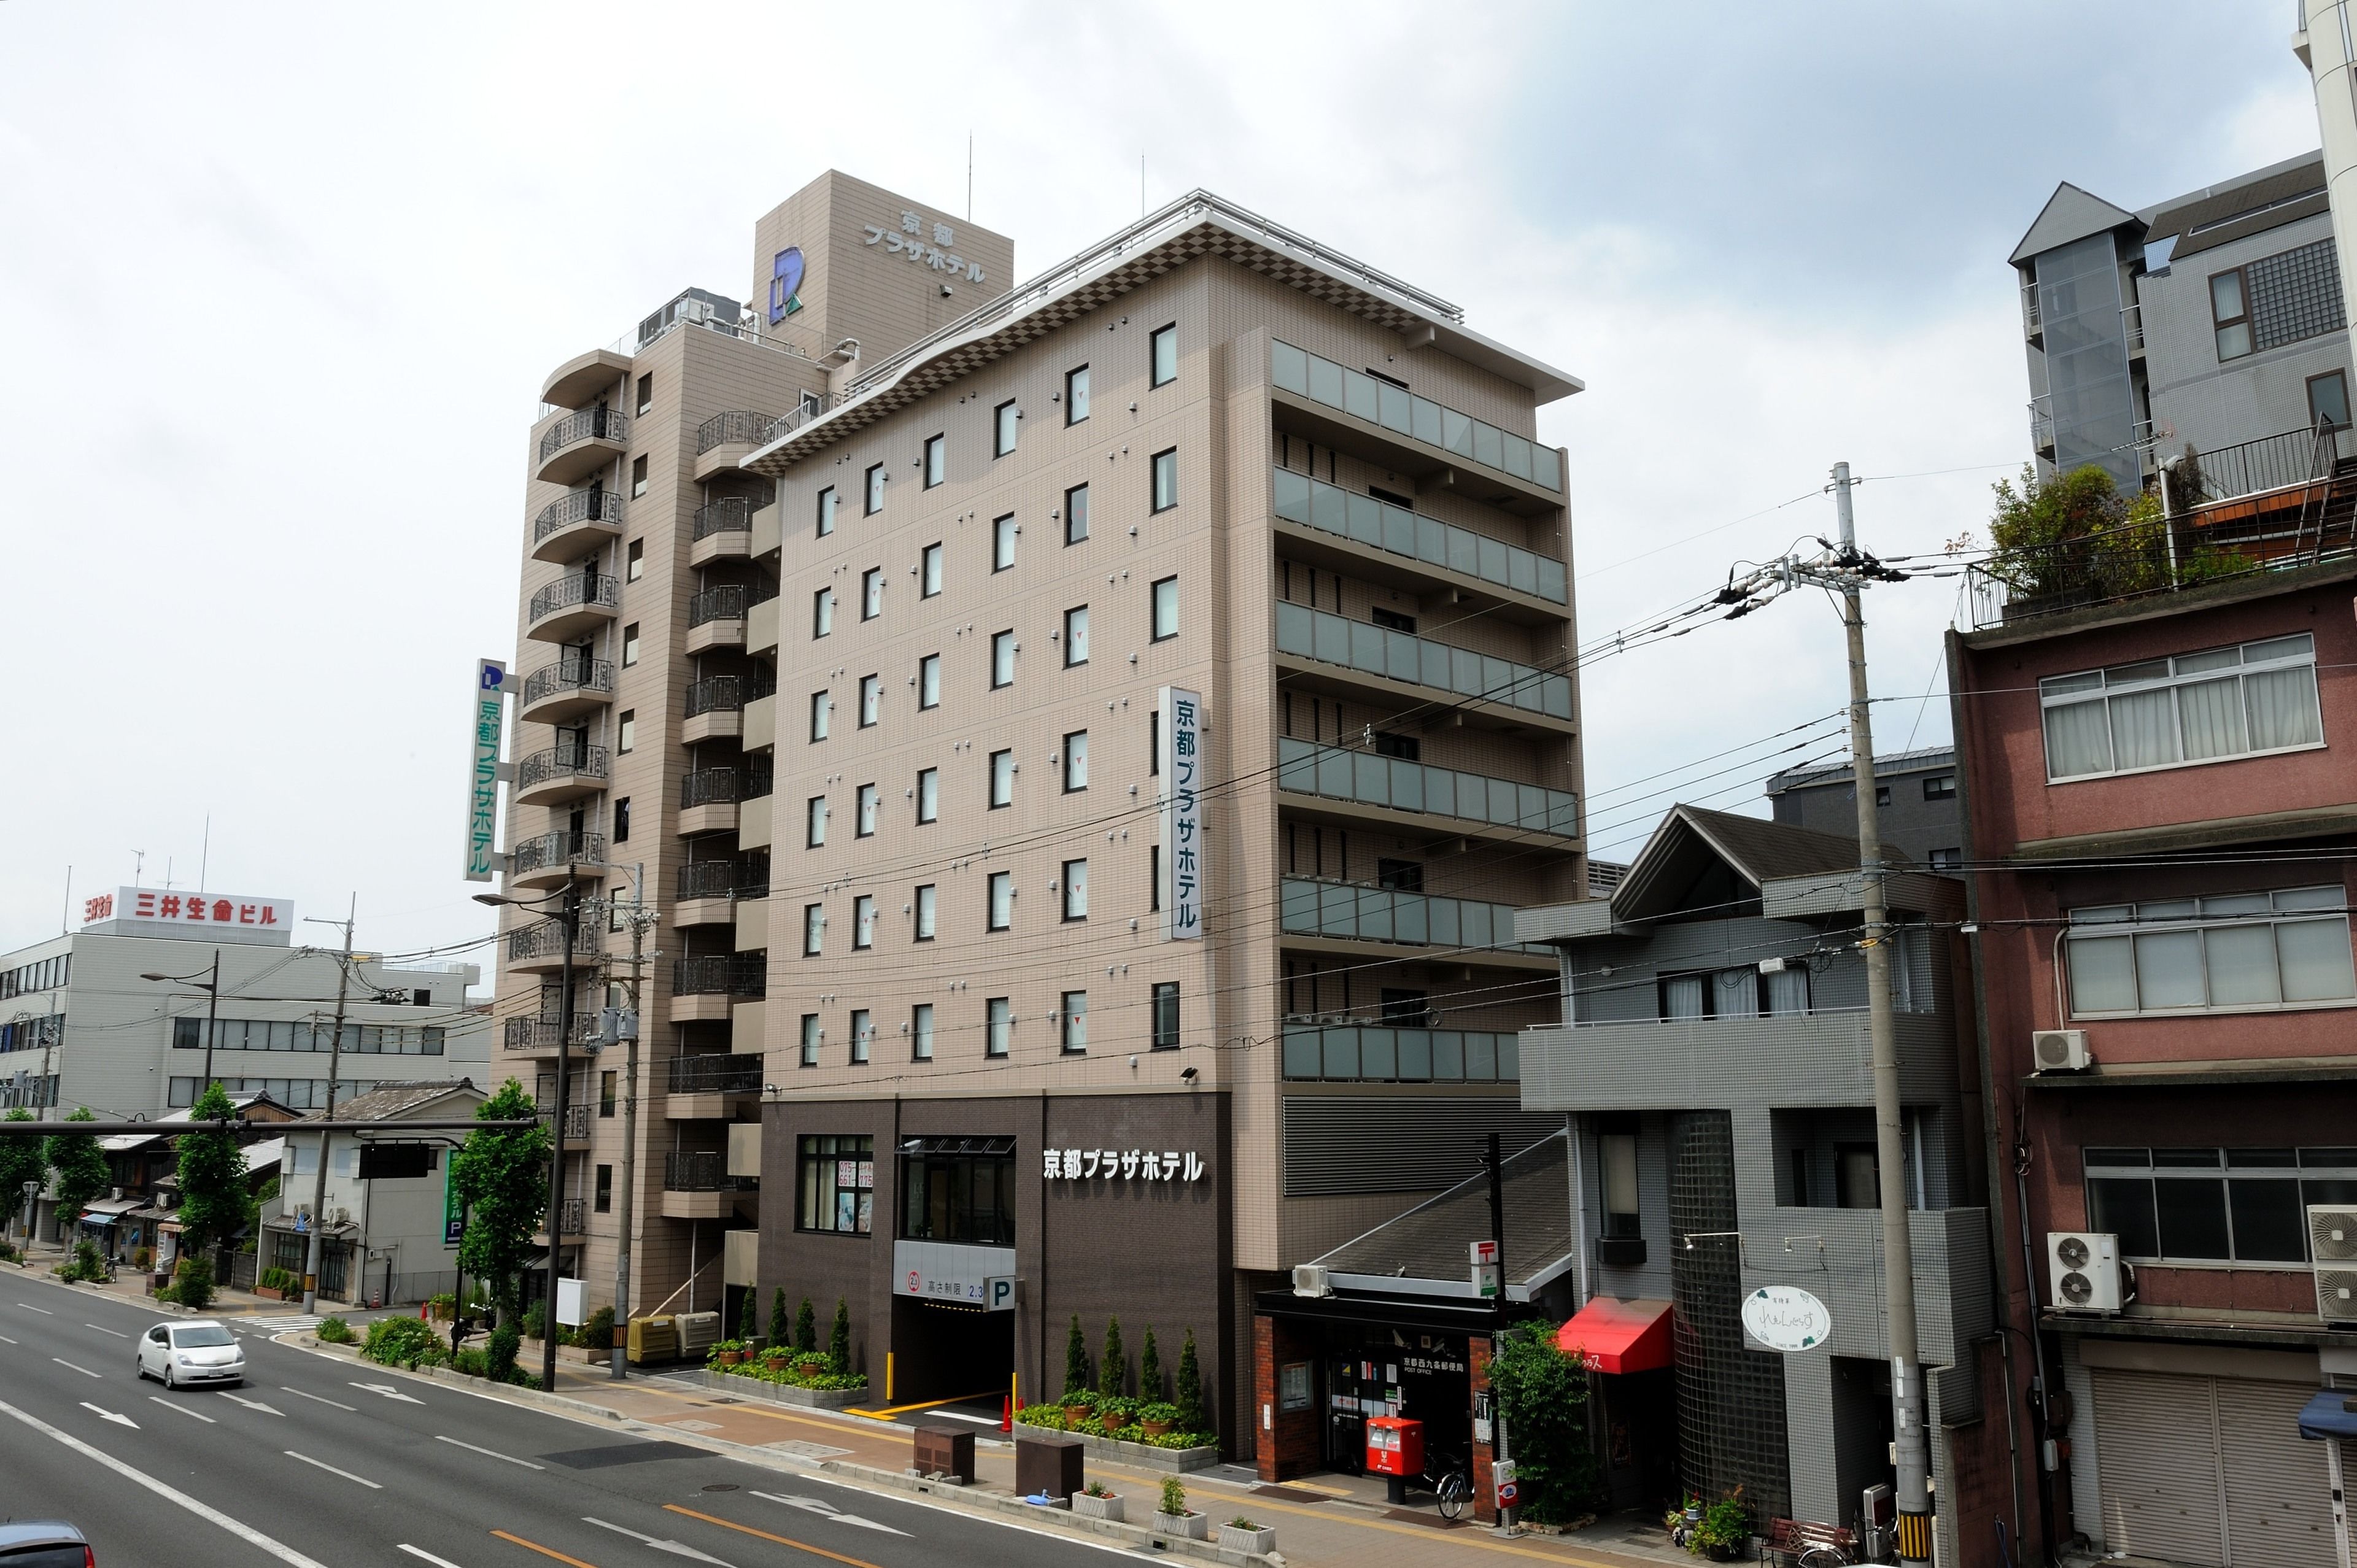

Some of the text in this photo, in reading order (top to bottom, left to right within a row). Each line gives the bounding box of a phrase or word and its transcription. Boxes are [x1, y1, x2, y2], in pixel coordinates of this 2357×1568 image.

[901, 210, 953, 247] 京都
[864, 225, 986, 284] プラザホテル
[470, 700, 500, 873] 京都プラザホテル
[1176, 699, 1197, 929] 京都プラザホテル
[136, 893, 277, 925] 三井生命ビル
[1043, 1148, 1204, 1182] 京都プラザホテル
[451, 1222, 462, 1234] P
[928, 1280, 961, 1296] 高さ制限
[994, 1281, 1010, 1307] P
